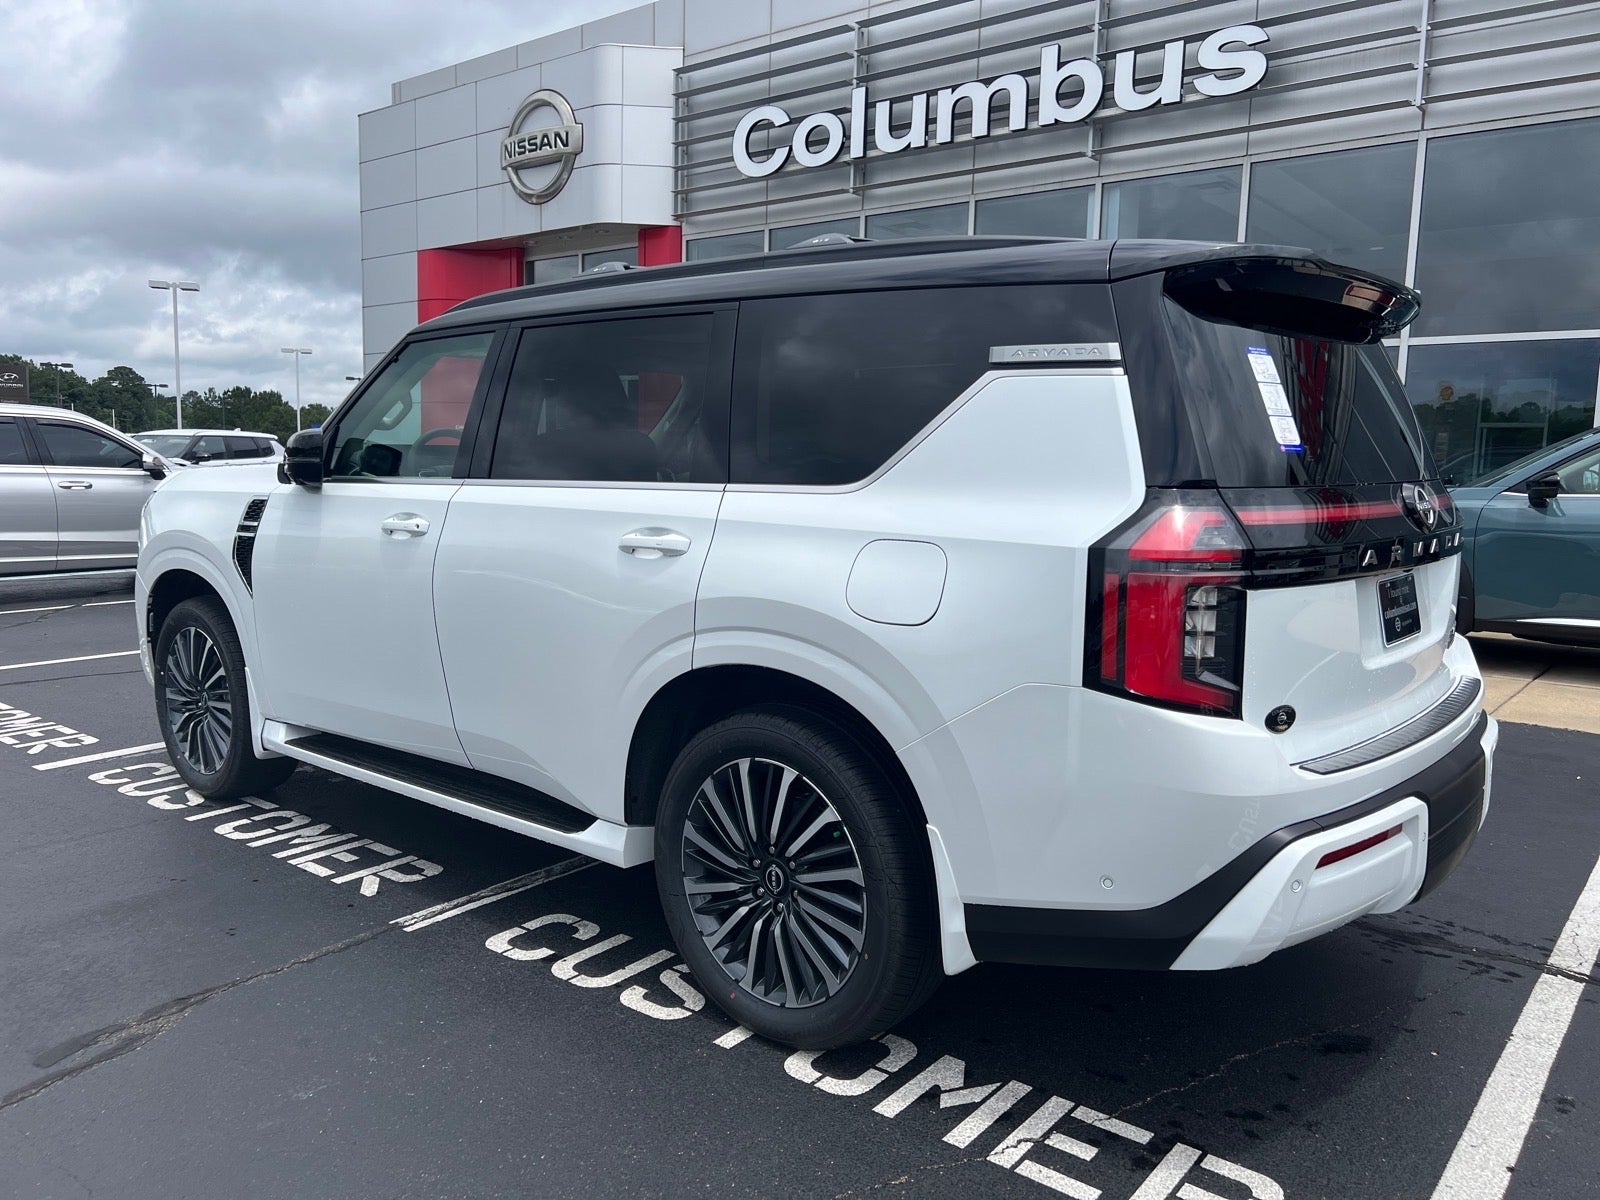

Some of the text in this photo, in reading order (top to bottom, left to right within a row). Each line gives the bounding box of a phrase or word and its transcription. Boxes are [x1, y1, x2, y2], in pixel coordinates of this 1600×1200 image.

[732, 25, 1269, 177] Columbus
[504, 131, 569, 160] NISSAN
[1011, 347, 1102, 358] ARMADA
